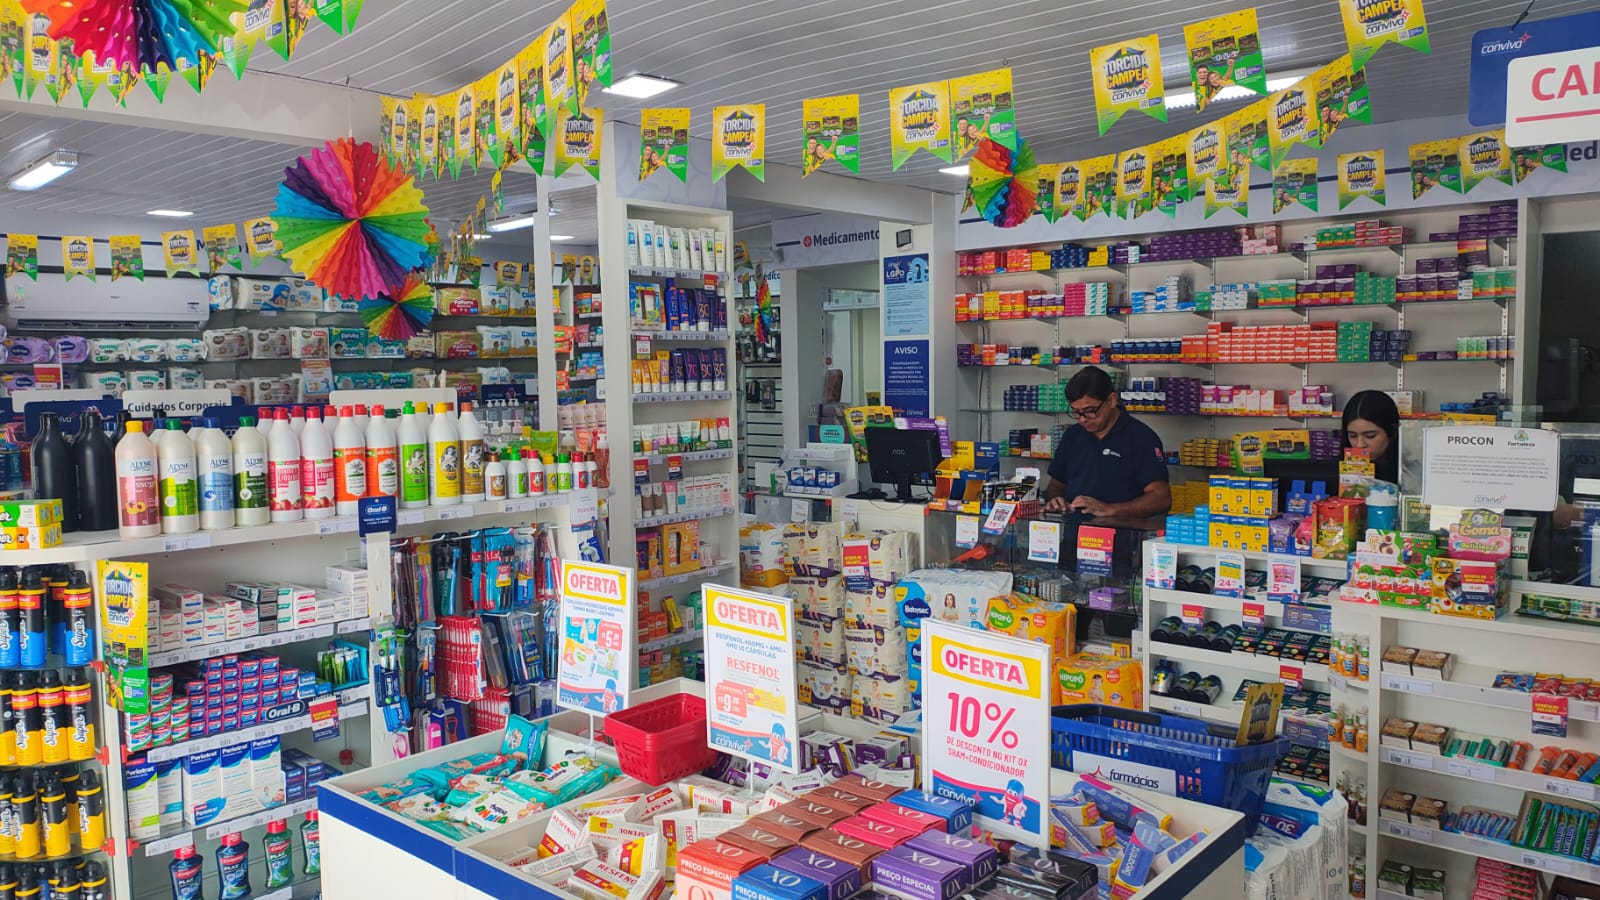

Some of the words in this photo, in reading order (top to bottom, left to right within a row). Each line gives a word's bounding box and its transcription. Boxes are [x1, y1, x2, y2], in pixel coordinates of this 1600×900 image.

[1103, 54, 1149, 75] TORCIDA
[1532, 61, 1600, 101] CA
[900, 98, 939, 114] TORCIDA
[722, 119, 755, 132] TORCIDA
[128, 401, 176, 414] Cuidados
[1448, 436, 1494, 446] PROCON
[1460, 525, 1500, 536] Goma
[570, 573, 618, 596] OFERTA
[717, 601, 779, 630] OFERTA
[71, 618, 88, 648] Super
[605, 631, 613, 648] 5
[726, 656, 781, 680] RESFENOL
[945, 649, 1023, 684] OFERTA
[268, 701, 301, 719] Oral-B
[723, 693, 732, 712] 9
[947, 692, 1019, 749] 10%
[946, 736, 955, 745] DE
[956, 739, 991, 757] DESCONTO
[992, 750, 1003, 760] NO
[1004, 753, 1016, 764] KIT
[1018, 757, 1029, 768] OX
[1109, 769, 1160, 789] farmácias
[597, 863, 637, 885] RESFENO
[680, 858, 702, 873] PREÇO
[877, 867, 901, 883] PREÇO
[902, 876, 936, 894] ESPECIAL
[735, 884, 758, 898] PREÇO
